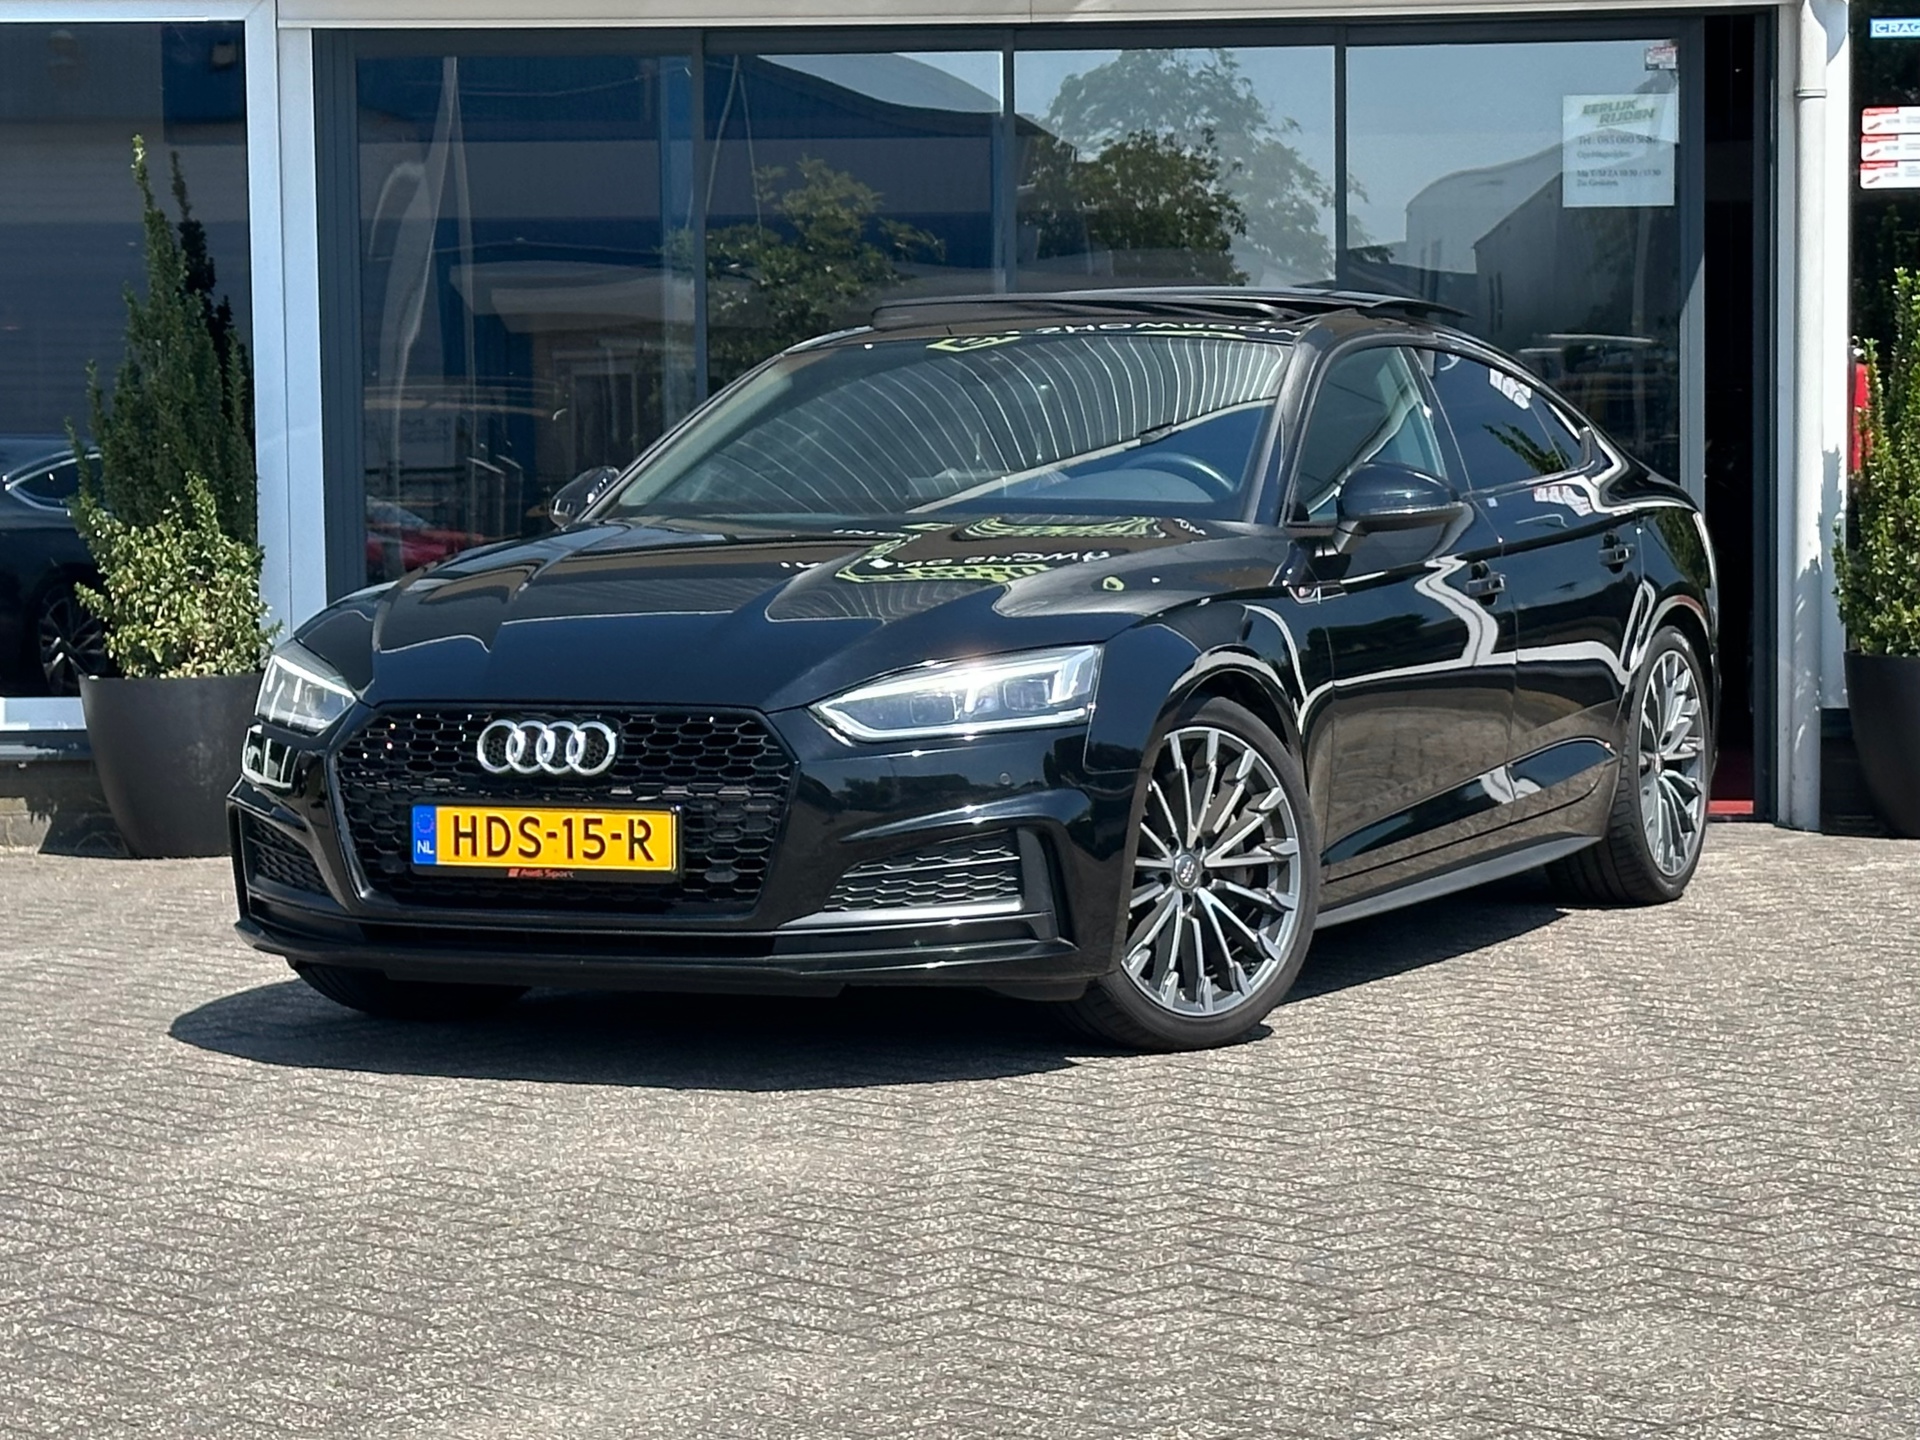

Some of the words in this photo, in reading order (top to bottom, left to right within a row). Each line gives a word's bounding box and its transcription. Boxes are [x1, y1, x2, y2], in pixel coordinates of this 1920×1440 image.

[1583, 100, 1638, 114] EERLIJK
[1599, 108, 1655, 123] RIJDEN
[452, 814, 655, 862] HDS-15-R
[416, 840, 434, 854] NL
